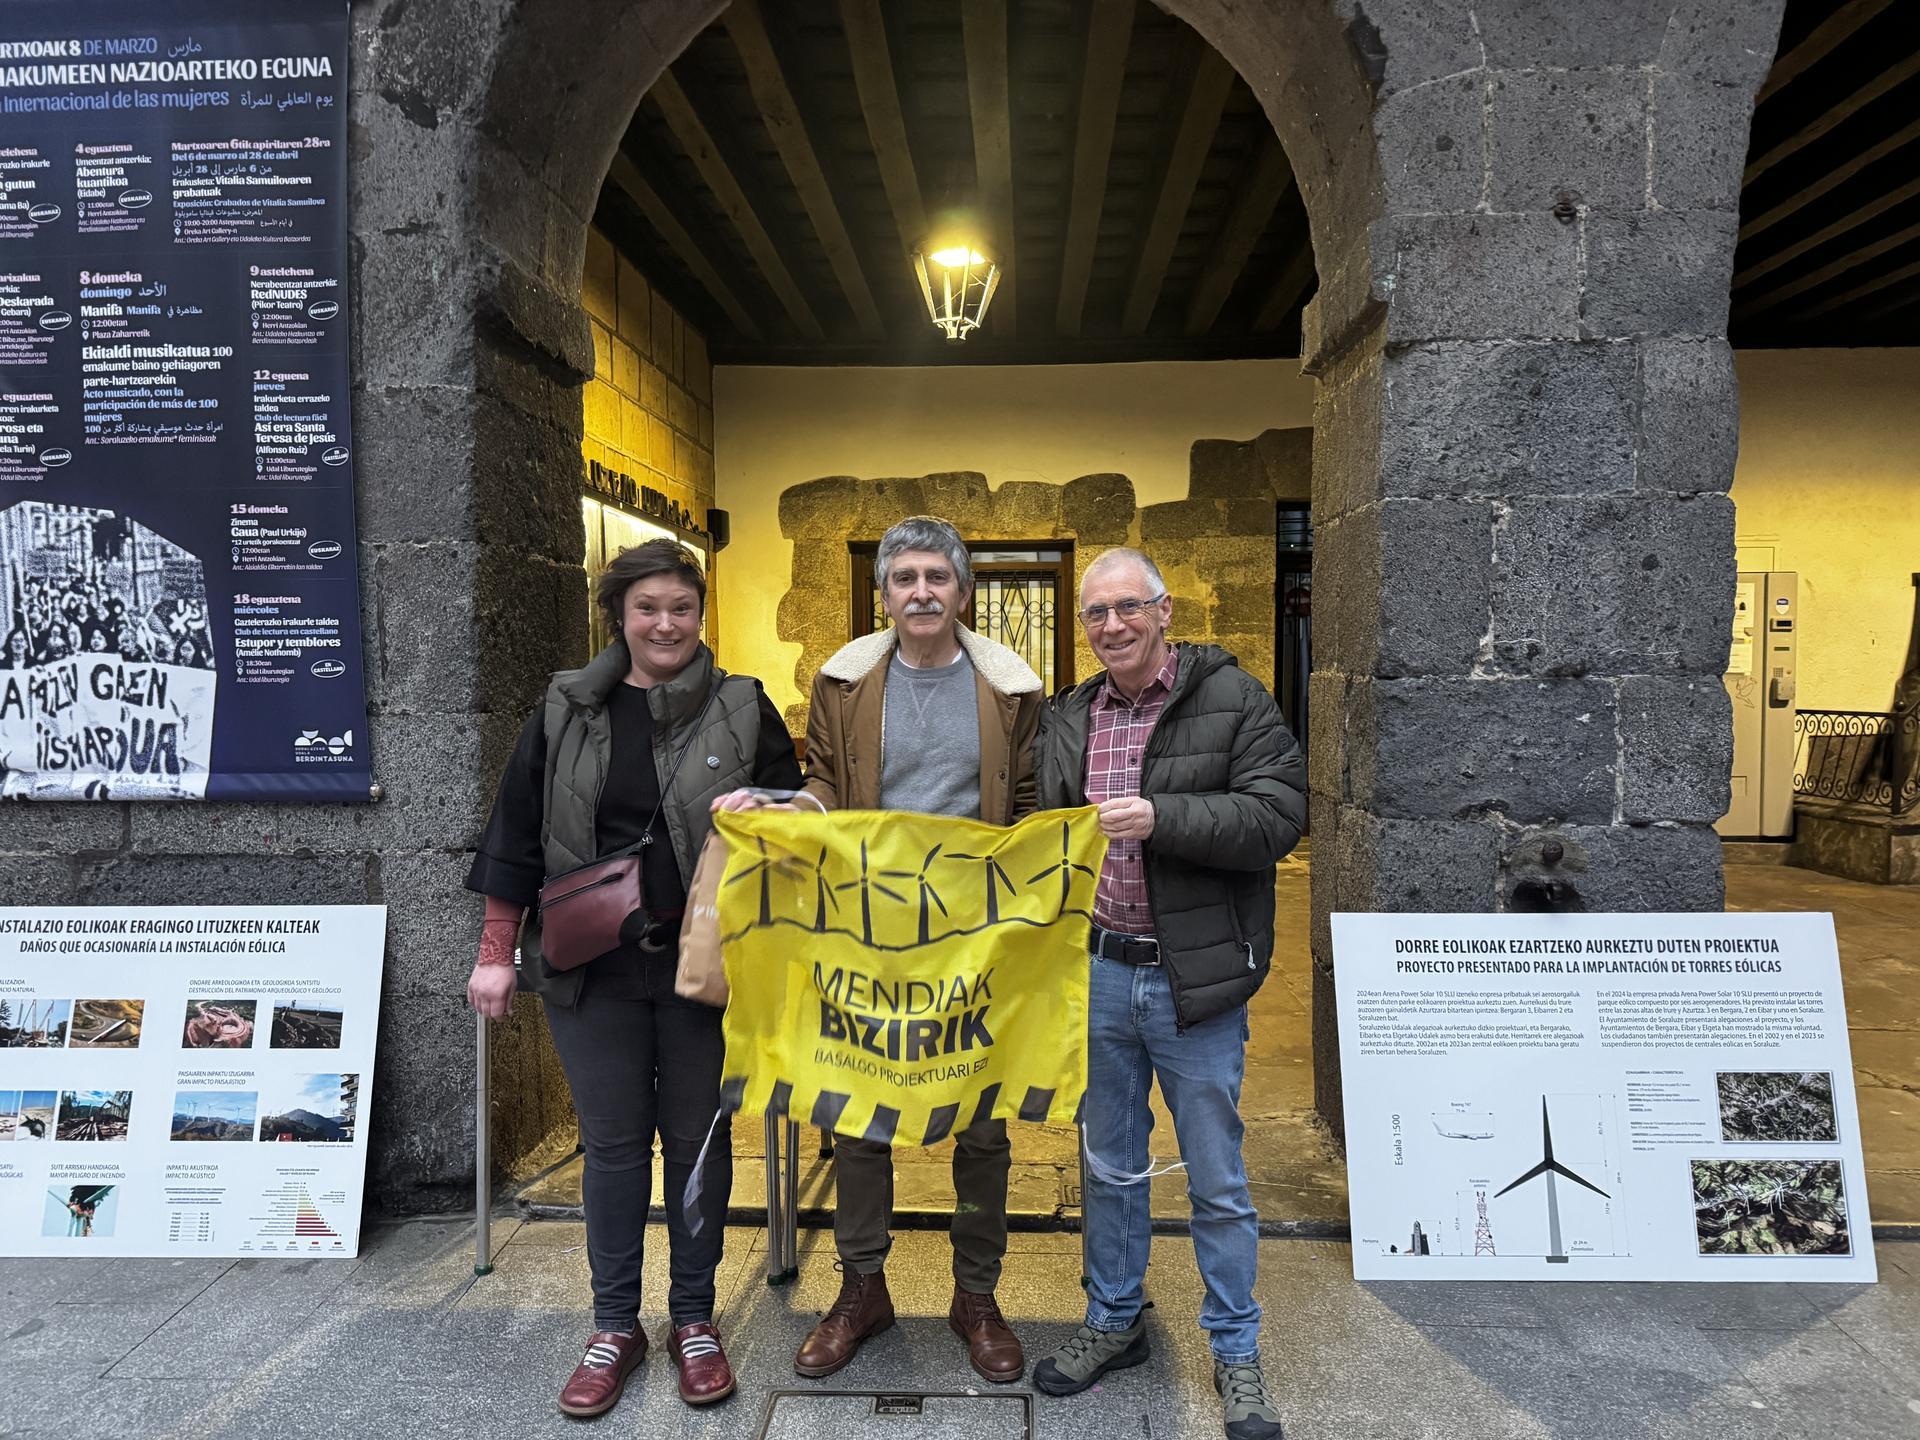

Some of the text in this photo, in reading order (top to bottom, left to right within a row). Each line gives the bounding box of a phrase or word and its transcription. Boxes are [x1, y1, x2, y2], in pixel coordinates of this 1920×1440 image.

[69, 40, 81, 56] 8
[84, 40, 102, 56] DE
[105, 38, 157, 55] MARZO
[168, 36, 202, 57] مارس
[111, 59, 257, 83] NAZIOARTEKO
[262, 57, 332, 79] EGUNA
[5, 89, 229, 112] Internacional de las mujeres
[75, 144, 132, 156] 4 eguaztena
[171, 137, 331, 151] Martxoaren 6tik apirilaren 28ra
[76, 158, 114, 167] Umeentzat
[76, 167, 124, 178] Abentura
[77, 176, 129, 188] kuantikoa
[172, 175, 312, 187] Erakusketa: Vitalia Samuilovaren
[173, 187, 222, 199] grabatuak
[250, 265, 314, 277] 9 astelehena
[80, 271, 142, 284] 8 domeka
[250, 280, 302, 289] Nerabeentzat
[80, 286, 132, 299] domingo
[251, 289, 307, 299] RedNUDES
[81, 303, 161, 317] Manifa Manifa
[251, 300, 303, 310] (Pikor Teatro)
[92, 319, 128, 328] 12:00etan
[92, 329, 150, 339] Plaza Zaharretik
[82, 344, 233, 359] Ekitaldi musikatua 100
[82, 360, 221, 372] emakume baino gehiagoren
[83, 375, 176, 388] parte-hartzearekin
[253, 370, 309, 382] 12 eguena
[83, 387, 184, 399] Acto musicado, con la
[253, 382, 285, 392] jueves
[254, 395, 296, 403] Irakurketa
[84, 399, 218, 412] participación de más de 100
[254, 404, 279, 412] taldea
[84, 413, 122, 424] mujeres
[255, 421, 325, 432] Así era Santa
[255, 432, 336, 445] Teresa de Jesús
[256, 445, 308, 455] (Alfonso Ruiz)
[230, 503, 288, 514] 15 domeka
[231, 518, 258, 526] Zinema
[231, 527, 259, 537] Gaua
[260, 528, 280, 538] (Paul
[234, 593, 301, 605] 18 eguaztena
[234, 606, 279, 614] miércoles
[283, 617, 314, 625] irakurle
[316, 617, 339, 625] taldea
[235, 637, 341, 649] Estupor y temblores
[236, 648, 301, 658] (Amélie Nothomb)
[66, 920, 128, 934] EOLIKOAK
[130, 920, 193, 934] ERAGINGO
[197, 920, 263, 934] LITUZKEEN
[266, 920, 320, 934] KALTEAK
[20, 939, 286, 954] DAÑOS QUE OCASIONARÍA LA INSTALACIÓN EÓLICA
[1395, 939, 1780, 954] DORRE EOLIKOAK EZARTZEKO AURKEZTU DUTEN PROIEKTUA
[1397, 958, 1782, 973] PROYECTO PRESENTADO PARA LA IMPLANTACIÓN DE TORRES EÓLICAS
[813, 961, 994, 1015] MENDIAK
[1606, 1016, 1648, 1024] Ayuntamiento
[1718, 1016, 1754, 1024] alegaciones
[820, 998, 994, 1062] BIZIRIK
[815, 1047, 877, 1077] BASALGO
[880, 1064, 969, 1087] PROIEKTUARI
[1392, 1114, 1403, 1166] Eskala 1:500
